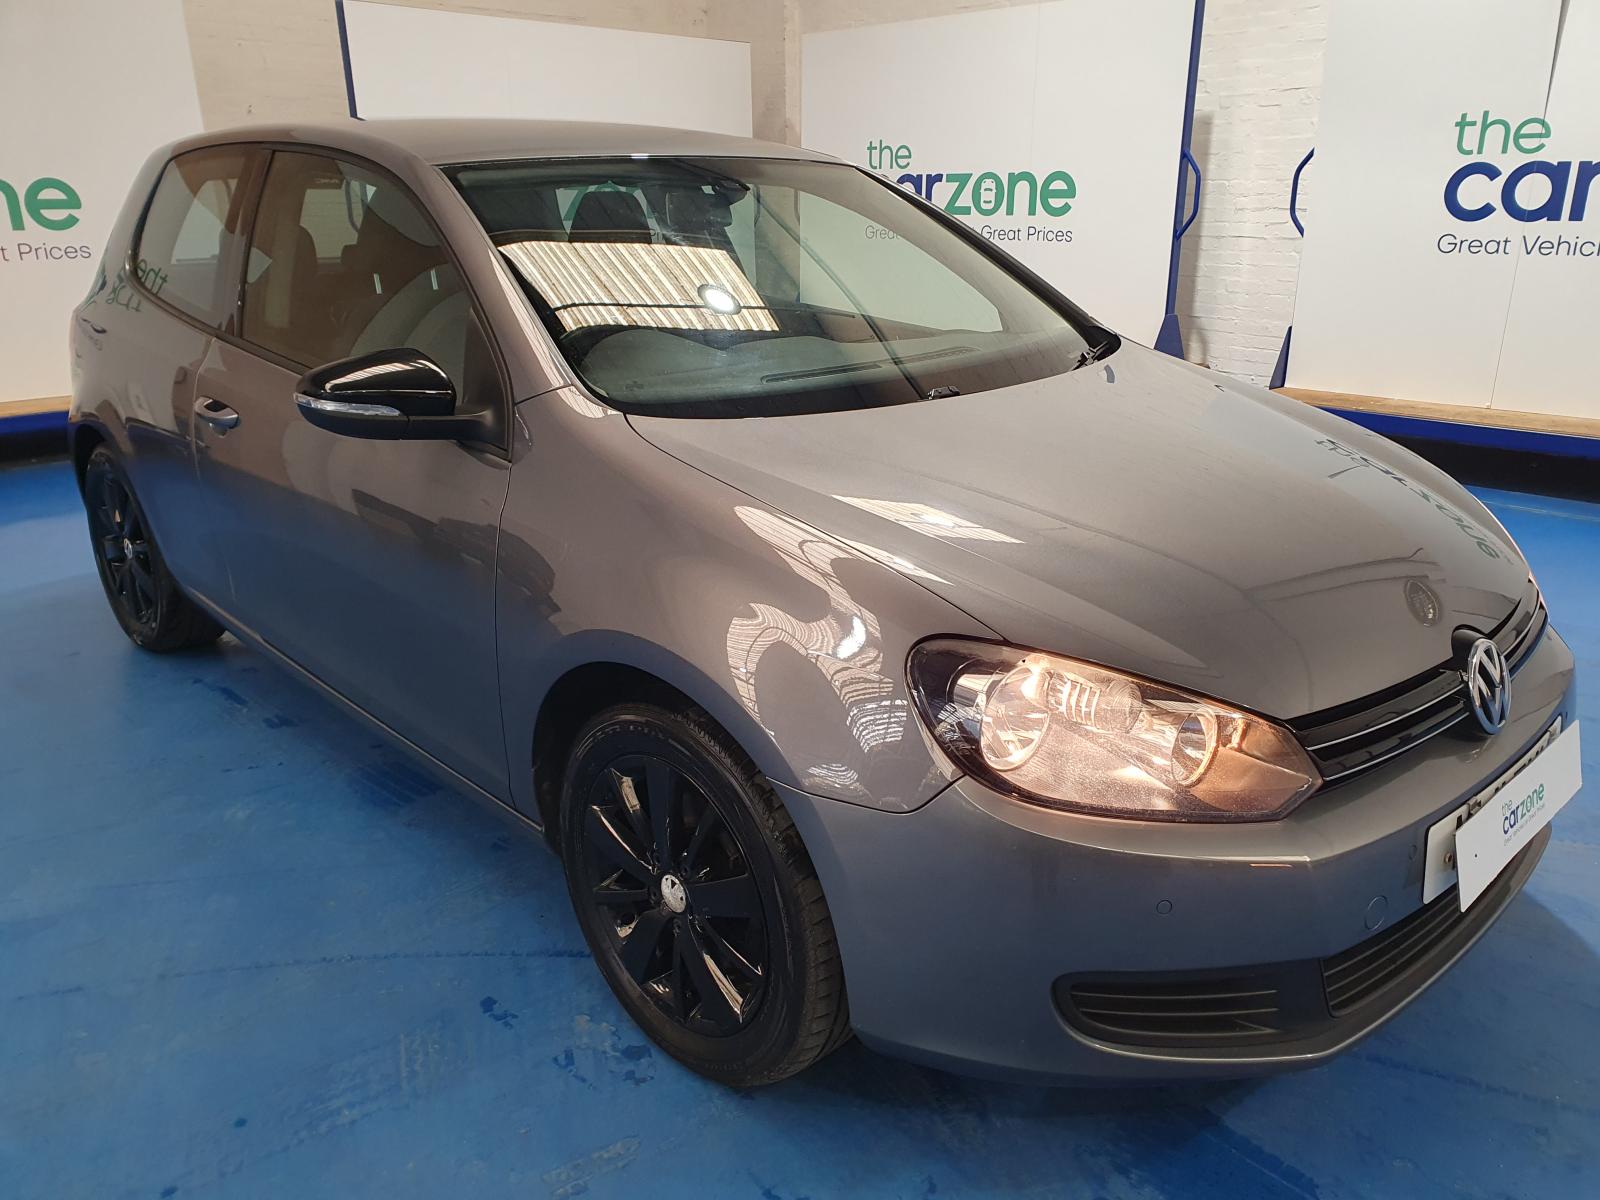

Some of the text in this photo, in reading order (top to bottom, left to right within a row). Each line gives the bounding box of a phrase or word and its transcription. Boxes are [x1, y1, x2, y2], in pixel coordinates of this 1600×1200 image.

[1454, 110, 1552, 156] the
[866, 139, 912, 170] the
[881, 170, 1077, 218] arzone
[980, 224, 1022, 241] Great
[1027, 226, 1073, 243] Prices
[1437, 233, 1512, 255] Great
[17, 242, 92, 261] Prices
[1501, 799, 1513, 817] the
[1502, 783, 1545, 835] carzone
